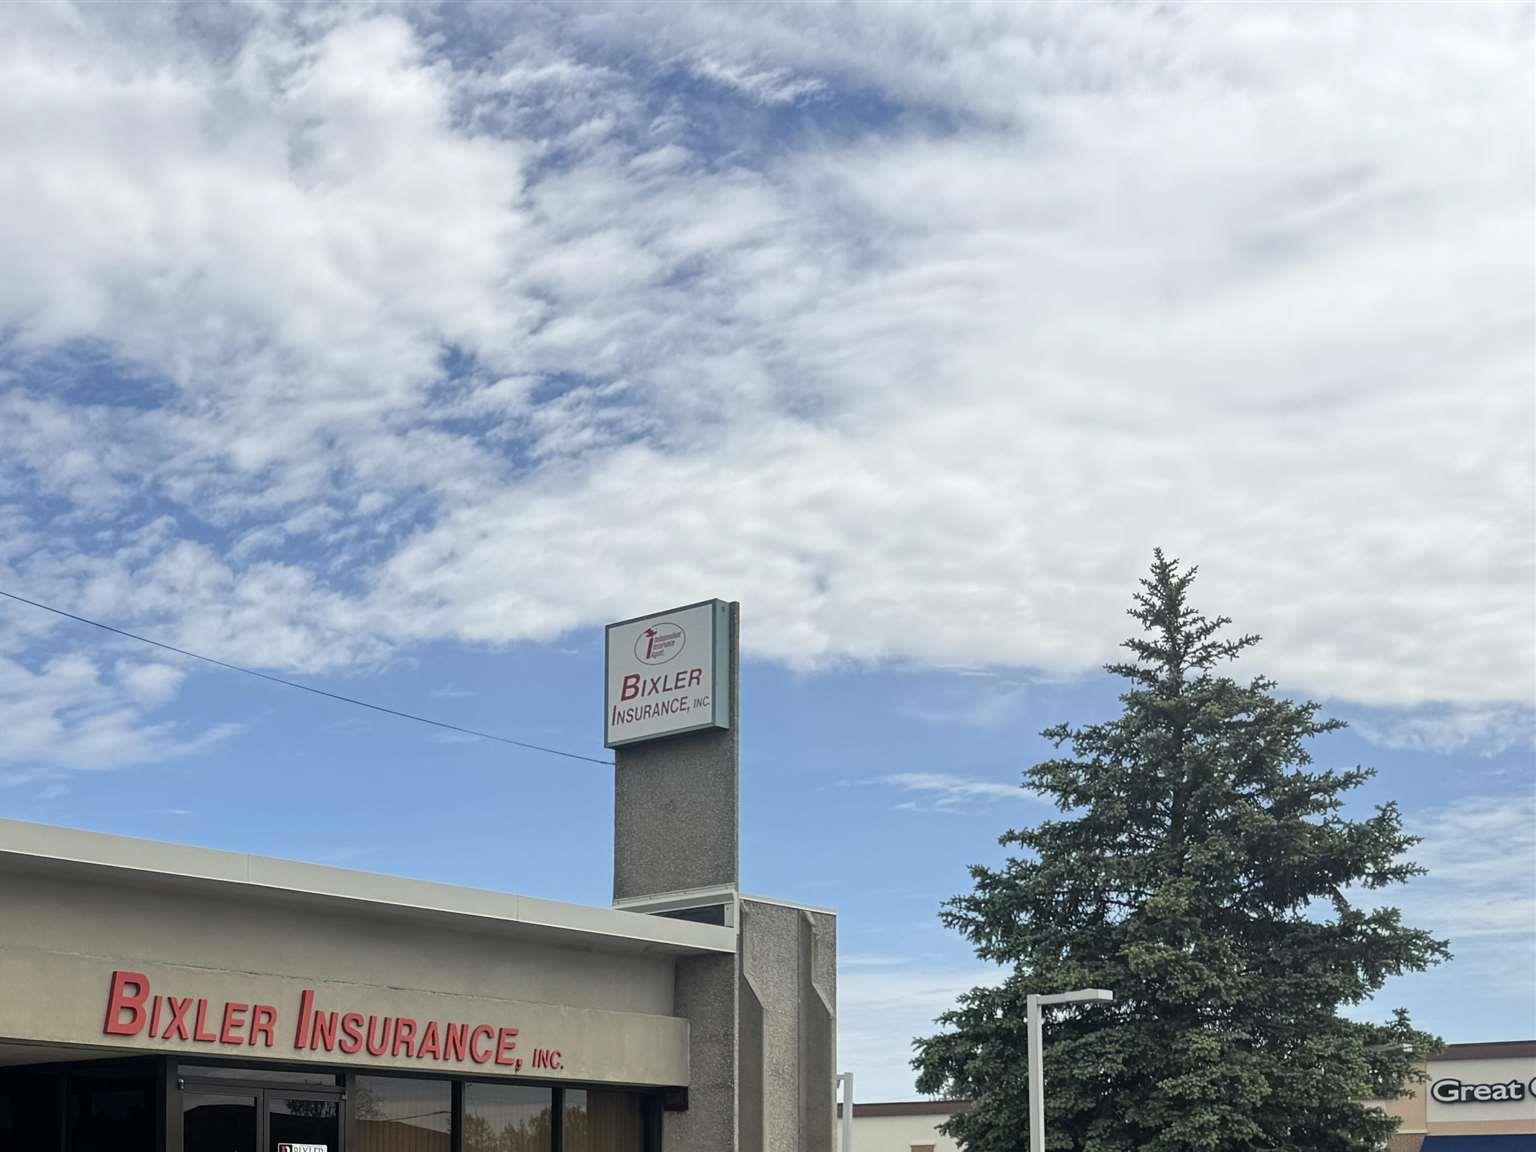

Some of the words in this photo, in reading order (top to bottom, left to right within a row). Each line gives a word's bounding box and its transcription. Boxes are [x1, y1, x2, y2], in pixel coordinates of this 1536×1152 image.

[621, 668, 703, 702] BIXLER
[104, 970, 278, 1047] BIXLER
[294, 989, 524, 1073] INSURANCE,
[532, 1047, 564, 1071] INC.
[1432, 1078, 1525, 1104] Great
